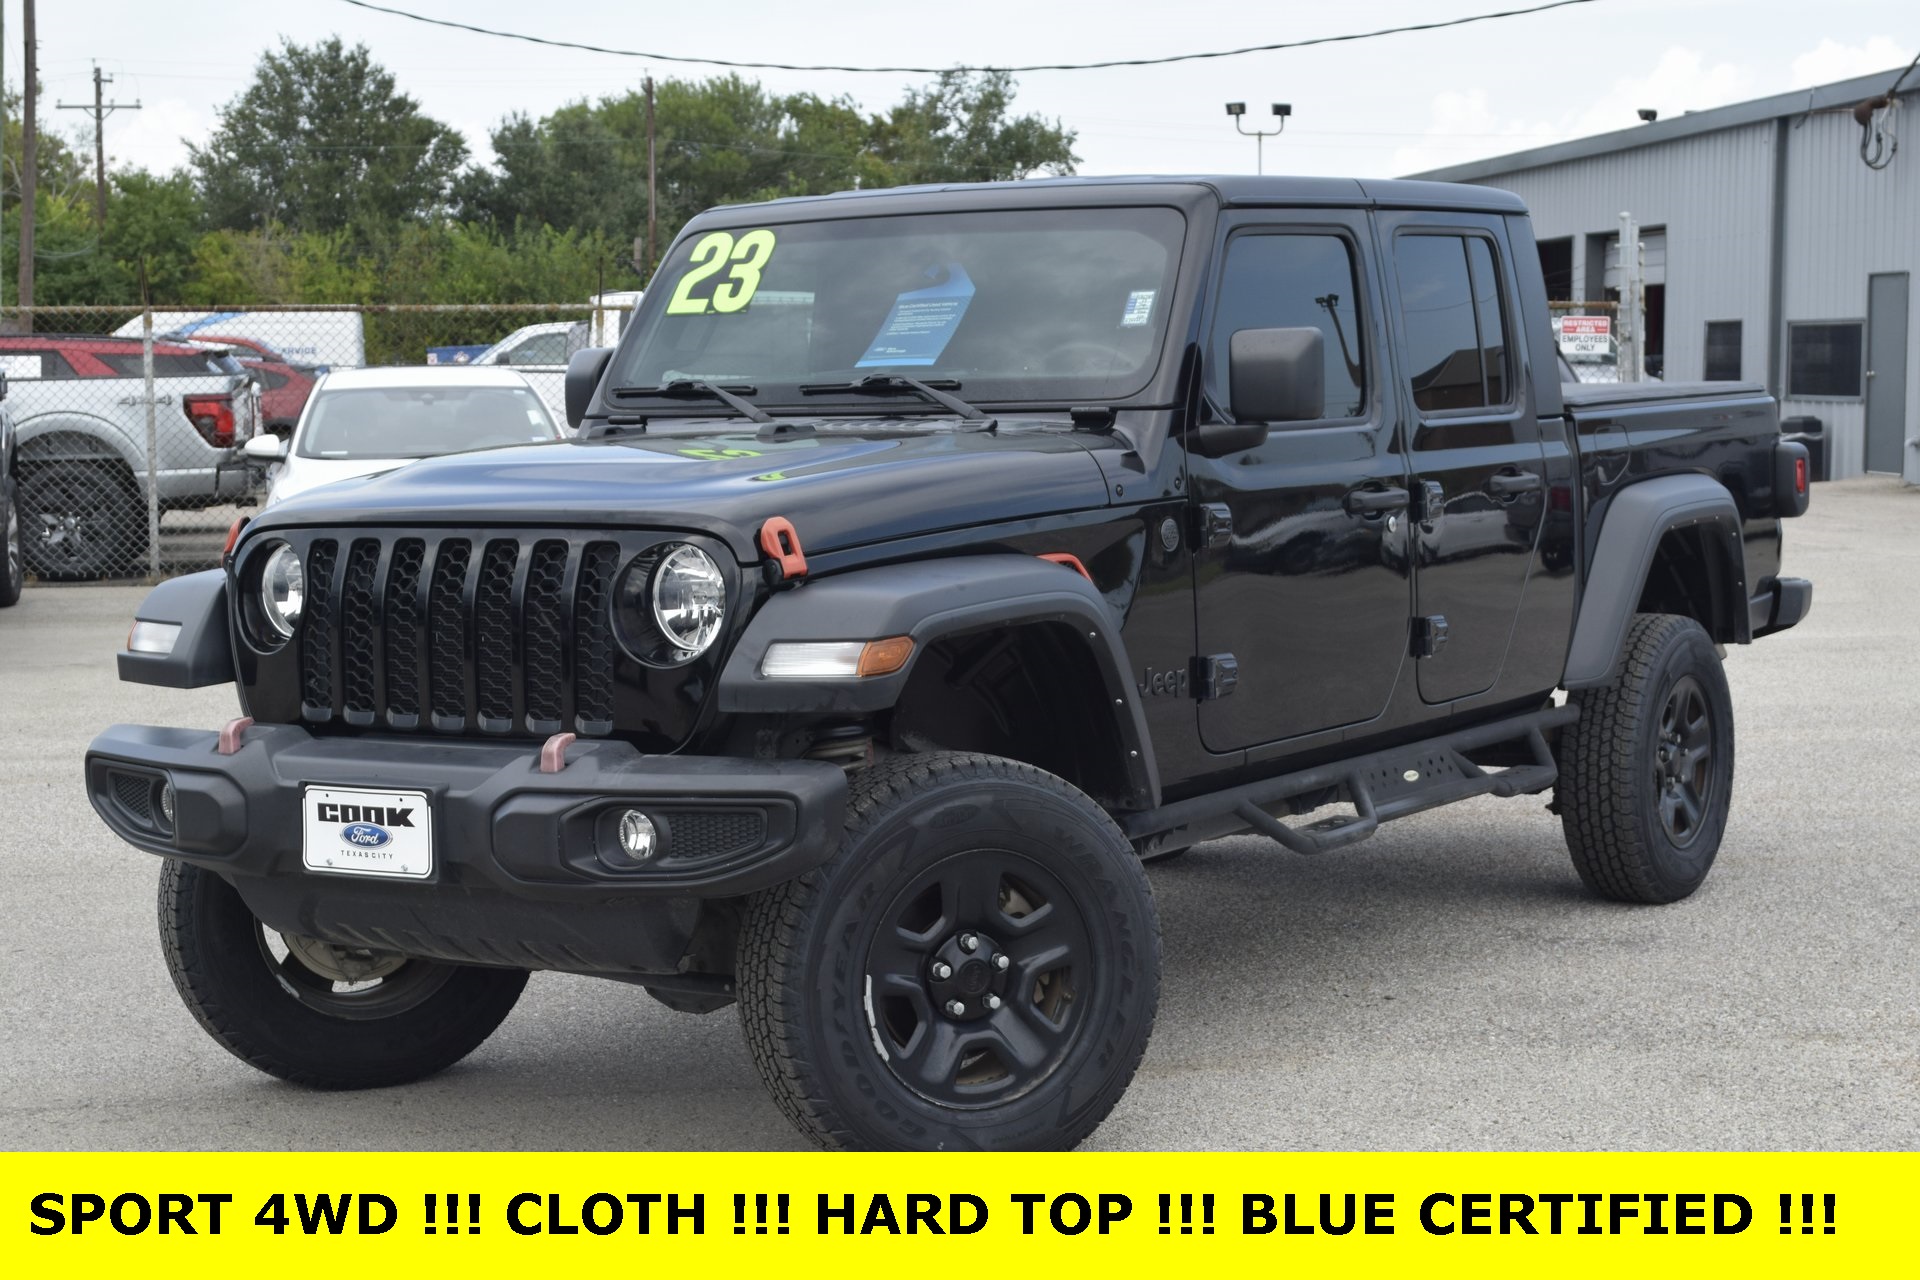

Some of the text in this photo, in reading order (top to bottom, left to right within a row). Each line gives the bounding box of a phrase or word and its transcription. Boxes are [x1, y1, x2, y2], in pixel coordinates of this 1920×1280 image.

[667, 230, 775, 314] 23
[1562, 335, 1608, 343] EMPLOYEES
[1138, 667, 1186, 698] Jeep
[317, 802, 416, 828] COOK
[351, 826, 379, 845] Ford
[1055, 826, 1135, 1069] WRANGLER
[831, 881, 926, 1139] GOODYEAR
